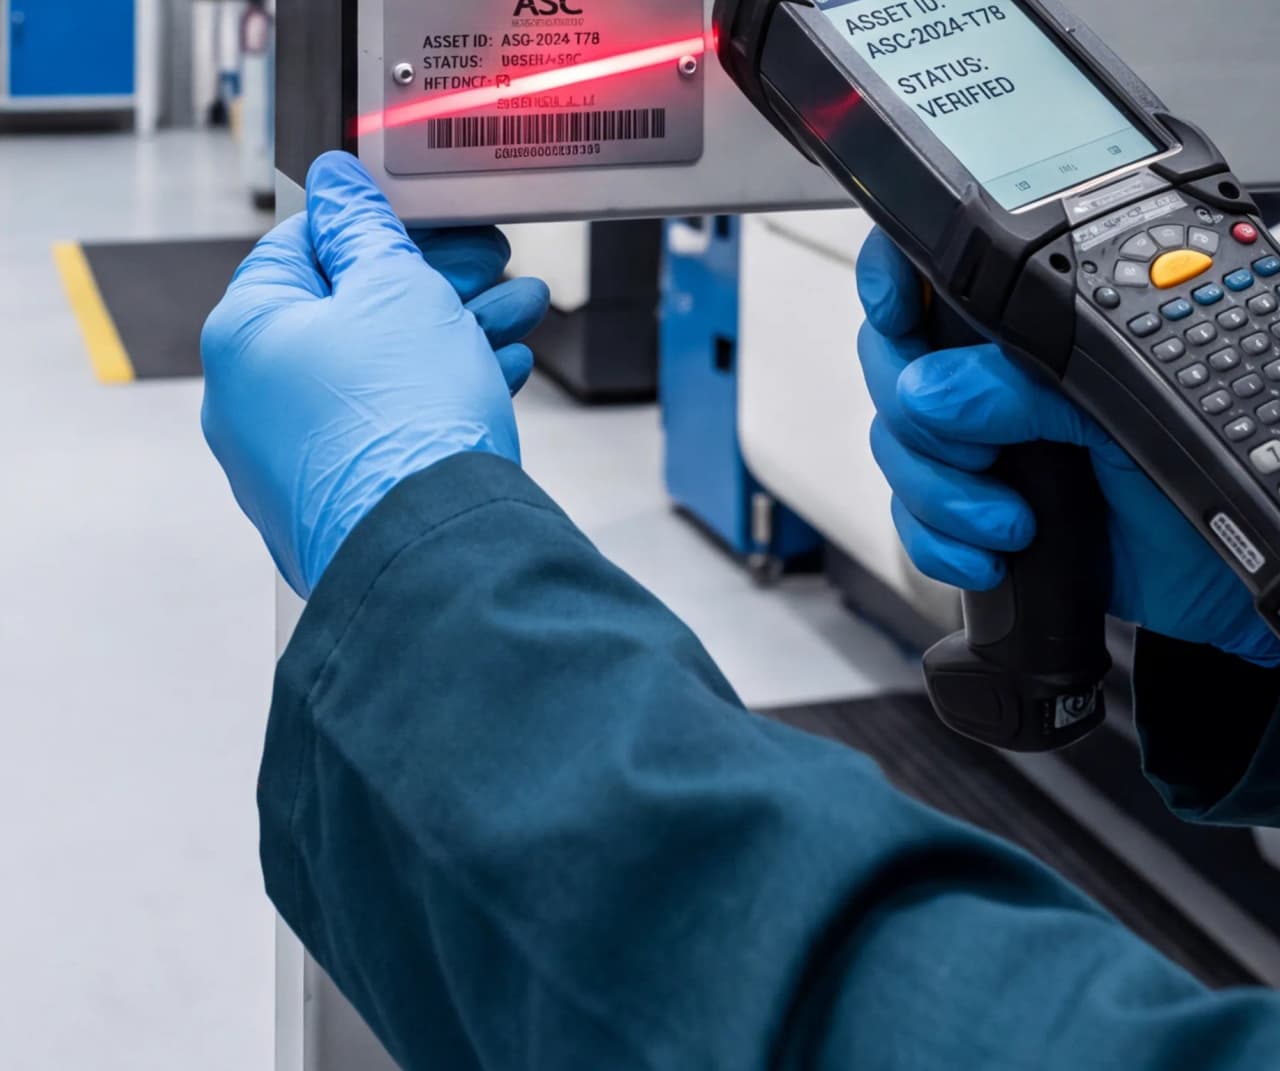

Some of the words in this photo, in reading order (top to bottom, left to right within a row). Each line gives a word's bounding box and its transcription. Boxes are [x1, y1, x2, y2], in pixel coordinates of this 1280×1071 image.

[845, 2, 913, 36] ASSET
[423, 34, 469, 49] ASSET
[473, 33, 493, 48] ID:
[423, 55, 483, 69] STATUS:
[897, 56, 989, 95] STATUS:
[917, 76, 1016, 118] VERIFIED
